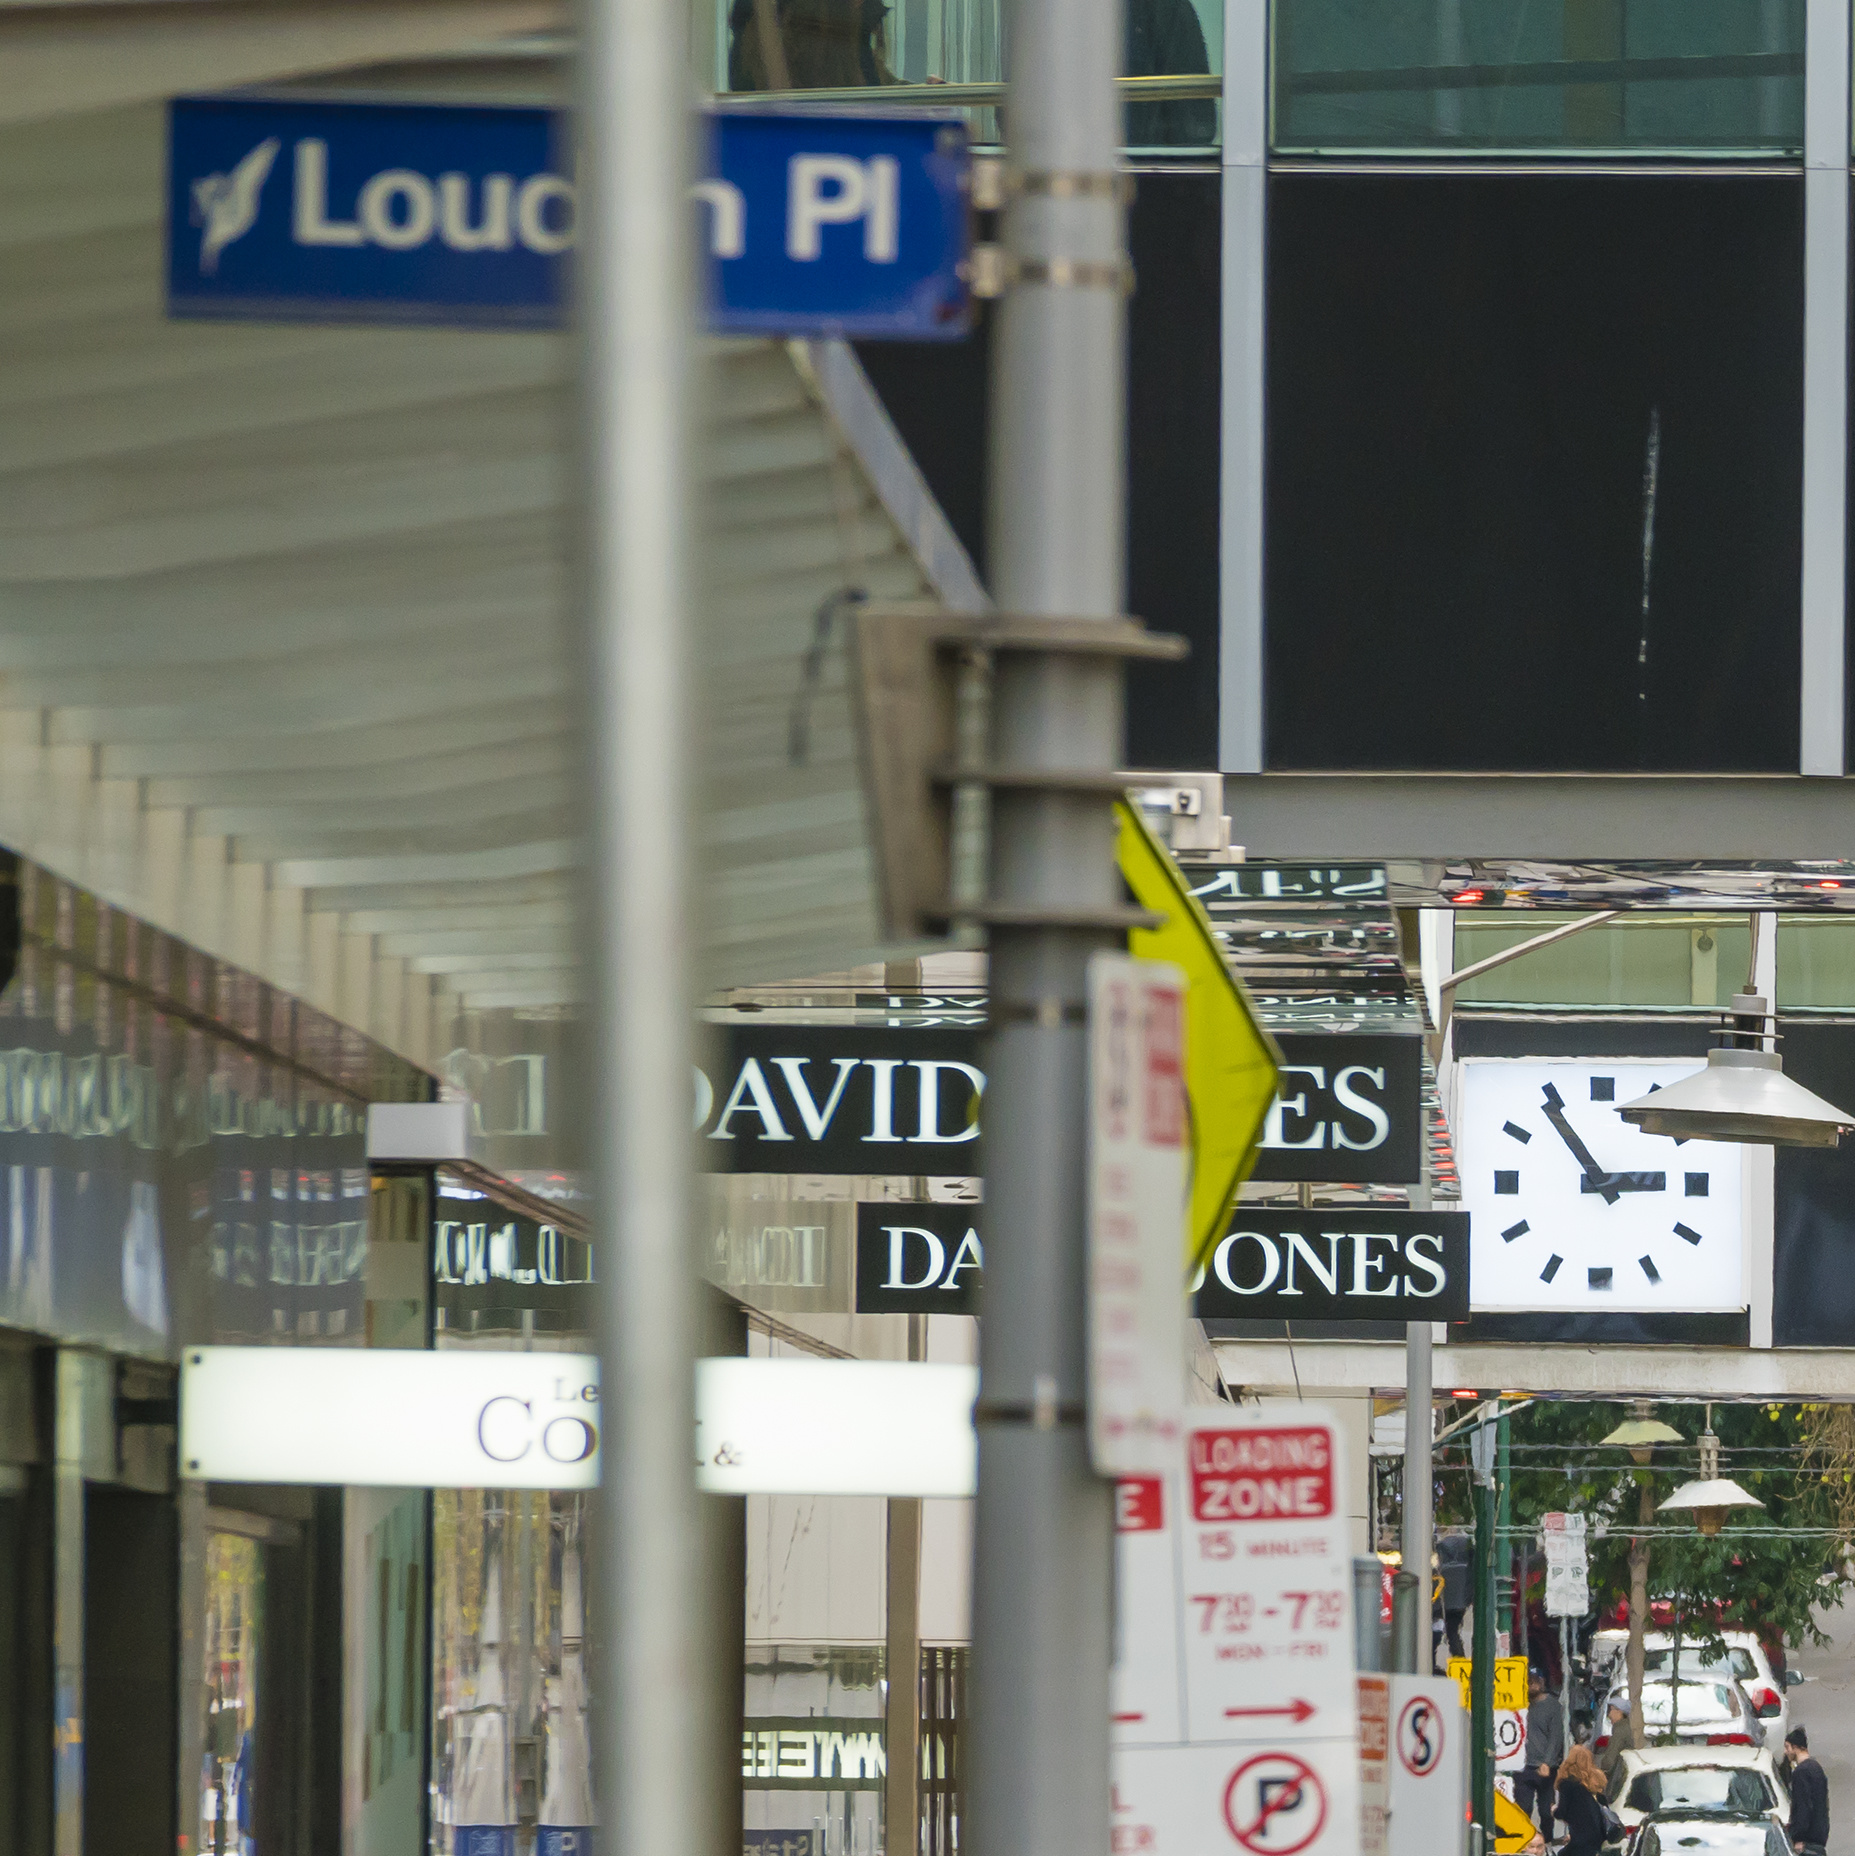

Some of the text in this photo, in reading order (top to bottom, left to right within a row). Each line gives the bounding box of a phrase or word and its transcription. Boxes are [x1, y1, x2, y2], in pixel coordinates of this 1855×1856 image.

[788, 153, 899, 265] Pl
[695, 1057, 987, 1143] AVID
[1189, 1231, 1448, 1298] ONES
[1192, 1433, 1328, 1473] LOADING
[1201, 1476, 1325, 1518] ZONE
